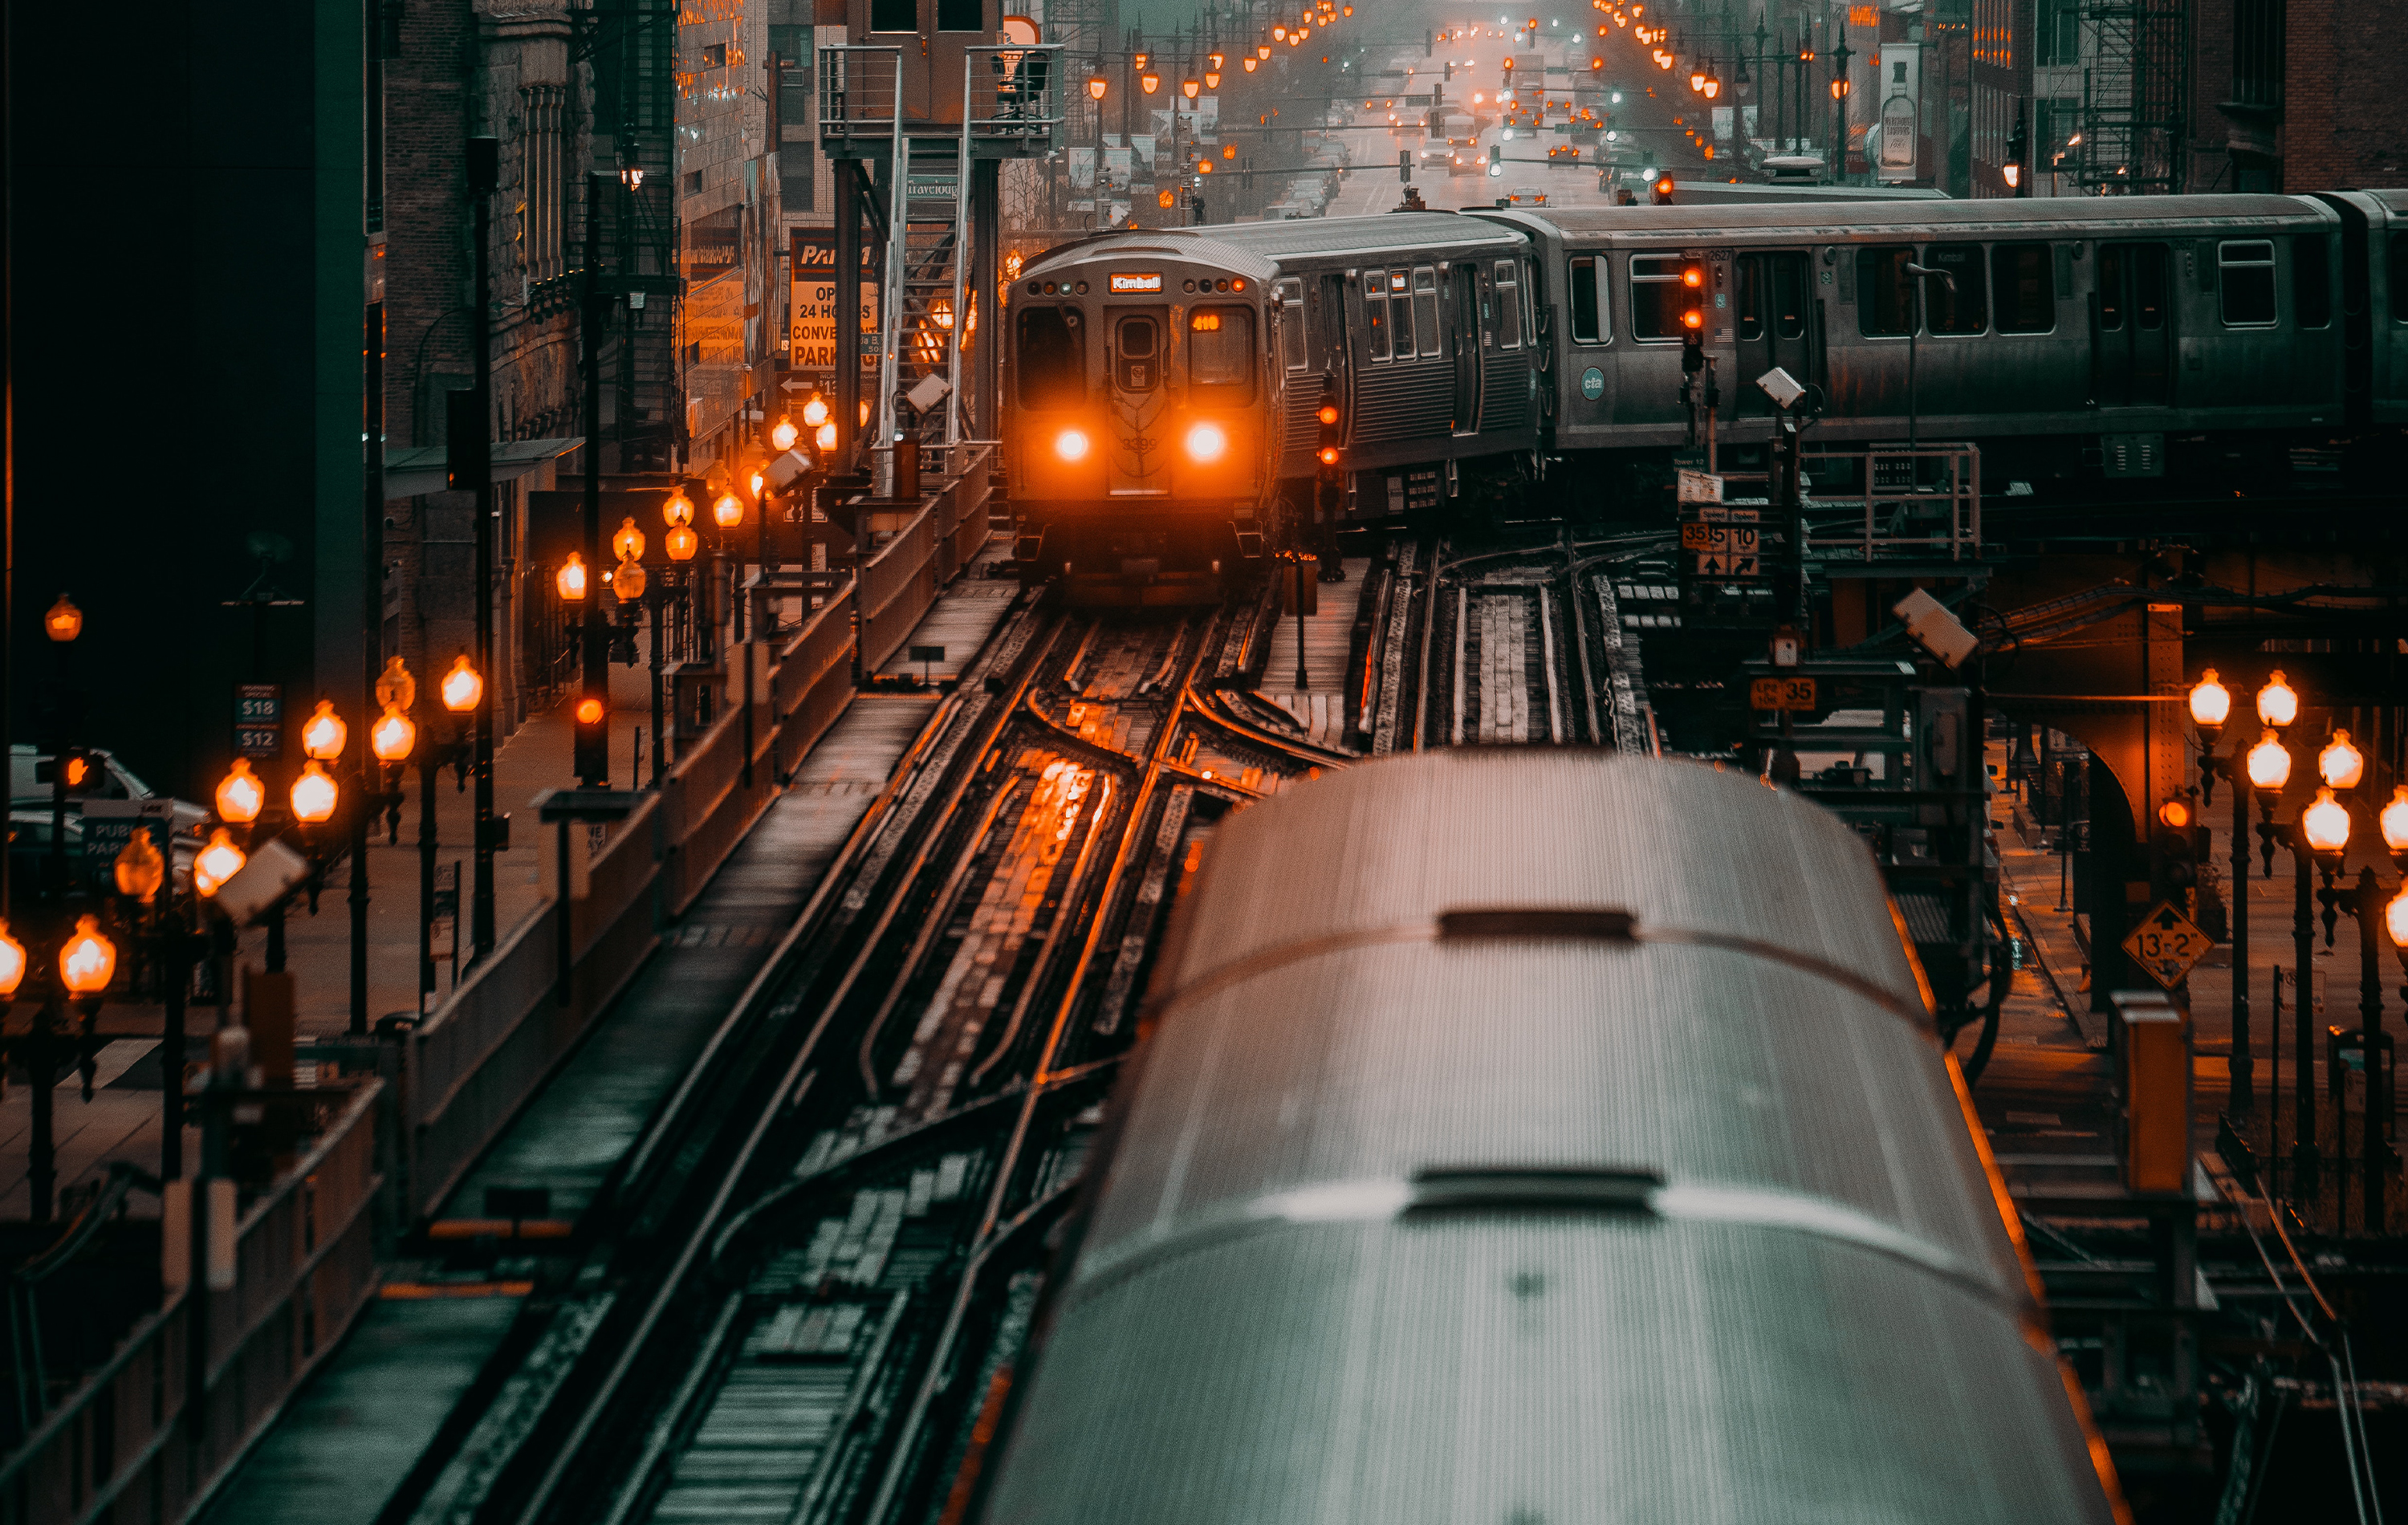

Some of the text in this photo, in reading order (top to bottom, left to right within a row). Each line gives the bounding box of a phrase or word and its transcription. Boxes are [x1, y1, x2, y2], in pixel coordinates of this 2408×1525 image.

[908, 180, 958, 199] Travelodg
[1710, 250, 1731, 262] 2627
[1938, 252, 1966, 262] Kimball
[1112, 276, 1161, 289] Kimball
[800, 305, 816, 319] 24
[1193, 315, 1219, 331] 410
[1584, 376, 1602, 389] cta
[1686, 526, 1706, 540] 35
[1735, 527, 1755, 545] 10
[1786, 682, 1812, 701] 35
[242, 699, 275, 716] $18
[242, 730, 274, 748] $12
